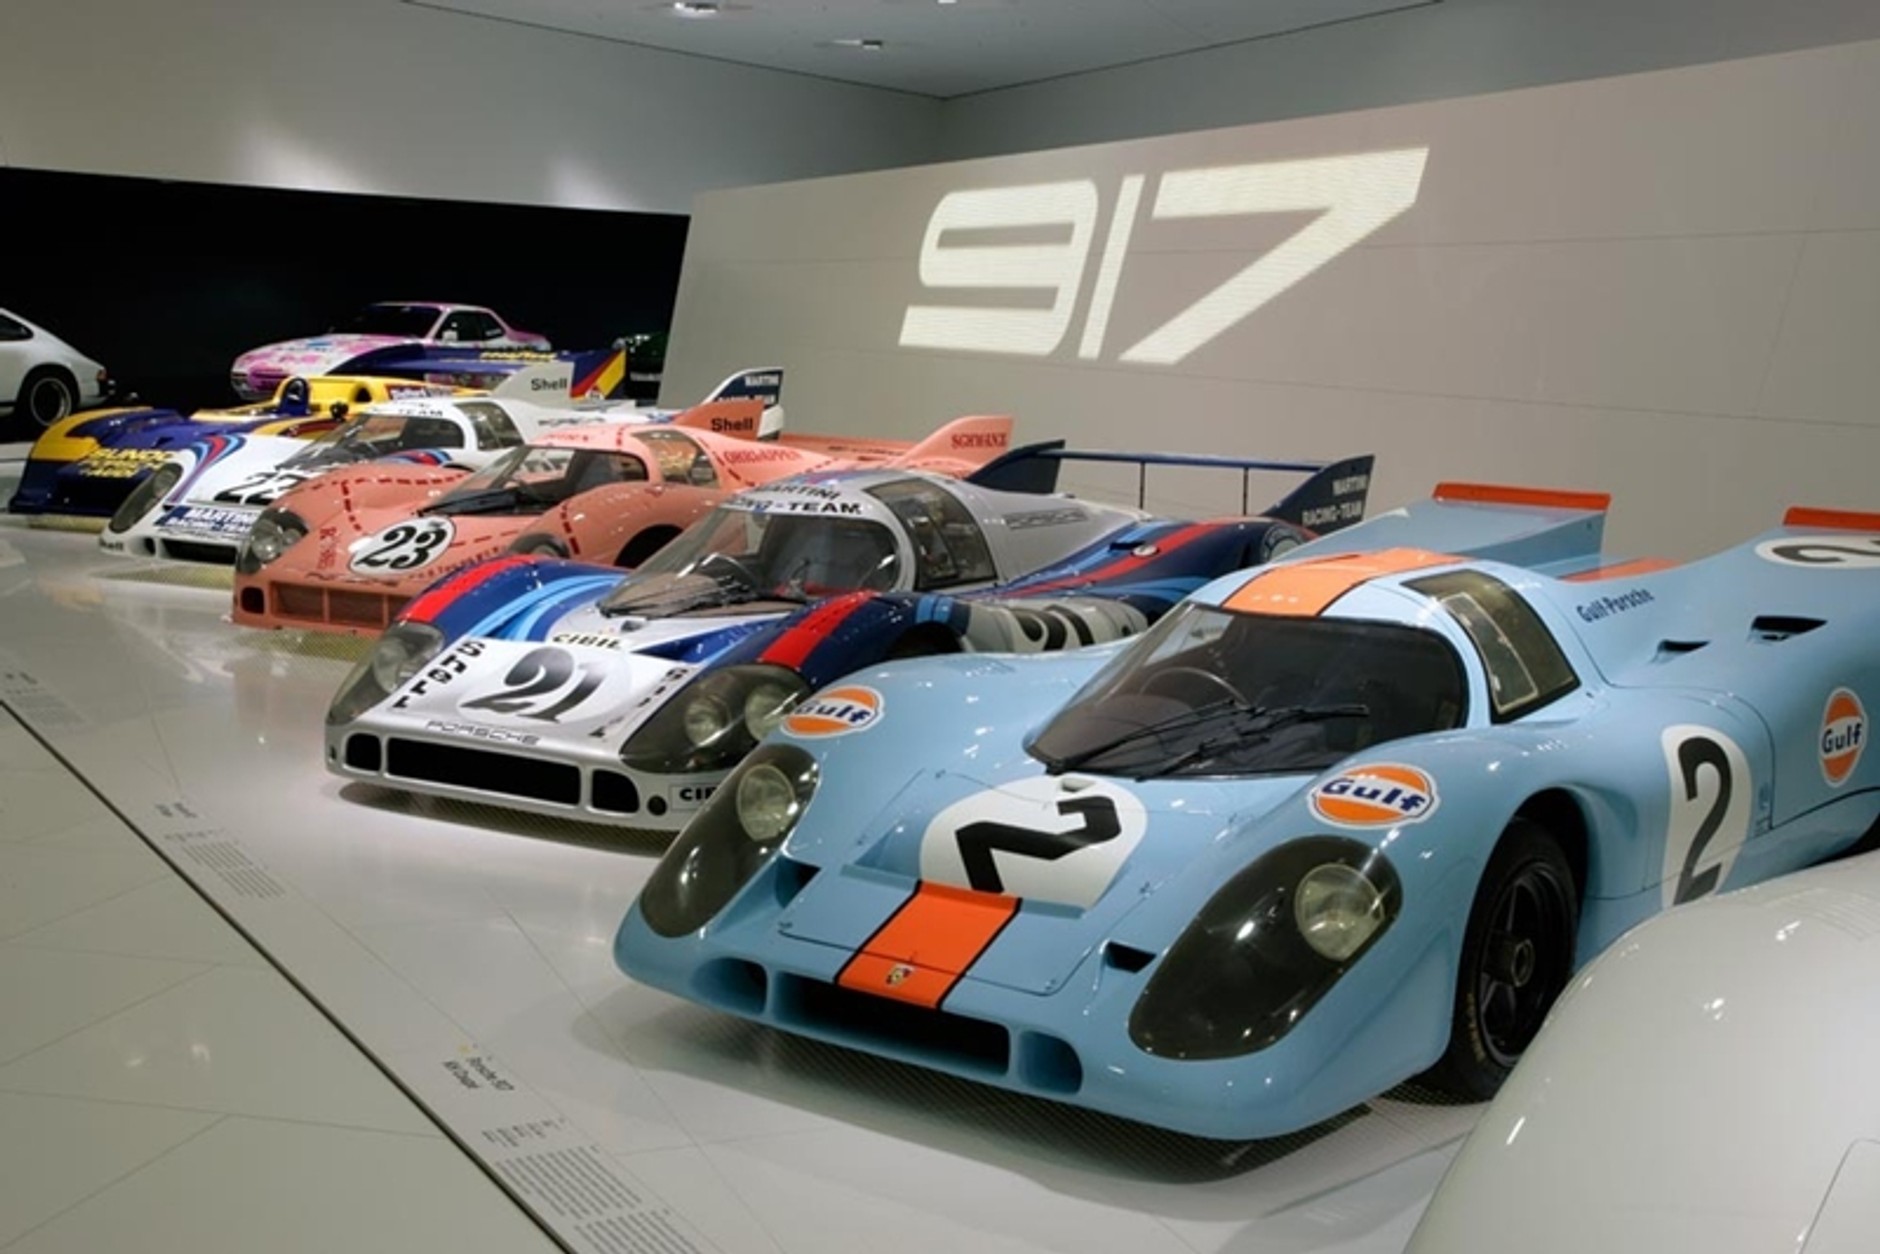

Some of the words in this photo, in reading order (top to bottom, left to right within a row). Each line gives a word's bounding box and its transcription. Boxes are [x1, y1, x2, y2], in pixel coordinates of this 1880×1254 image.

[899, 147, 1430, 365] 917
[531, 378, 568, 391] Shell
[711, 416, 754, 432] Shell
[213, 471, 306, 505] 22
[354, 525, 447, 569] 23
[1576, 588, 1655, 622] Gulf-Porsche
[460, 646, 608, 723] 21
[797, 699, 872, 724] Gulf
[425, 720, 541, 746] PORSCHE
[1822, 716, 1863, 753] Gulf
[1322, 776, 1427, 812] Gulf
[1673, 736, 1733, 906] 2
[955, 795, 1122, 893] 2
